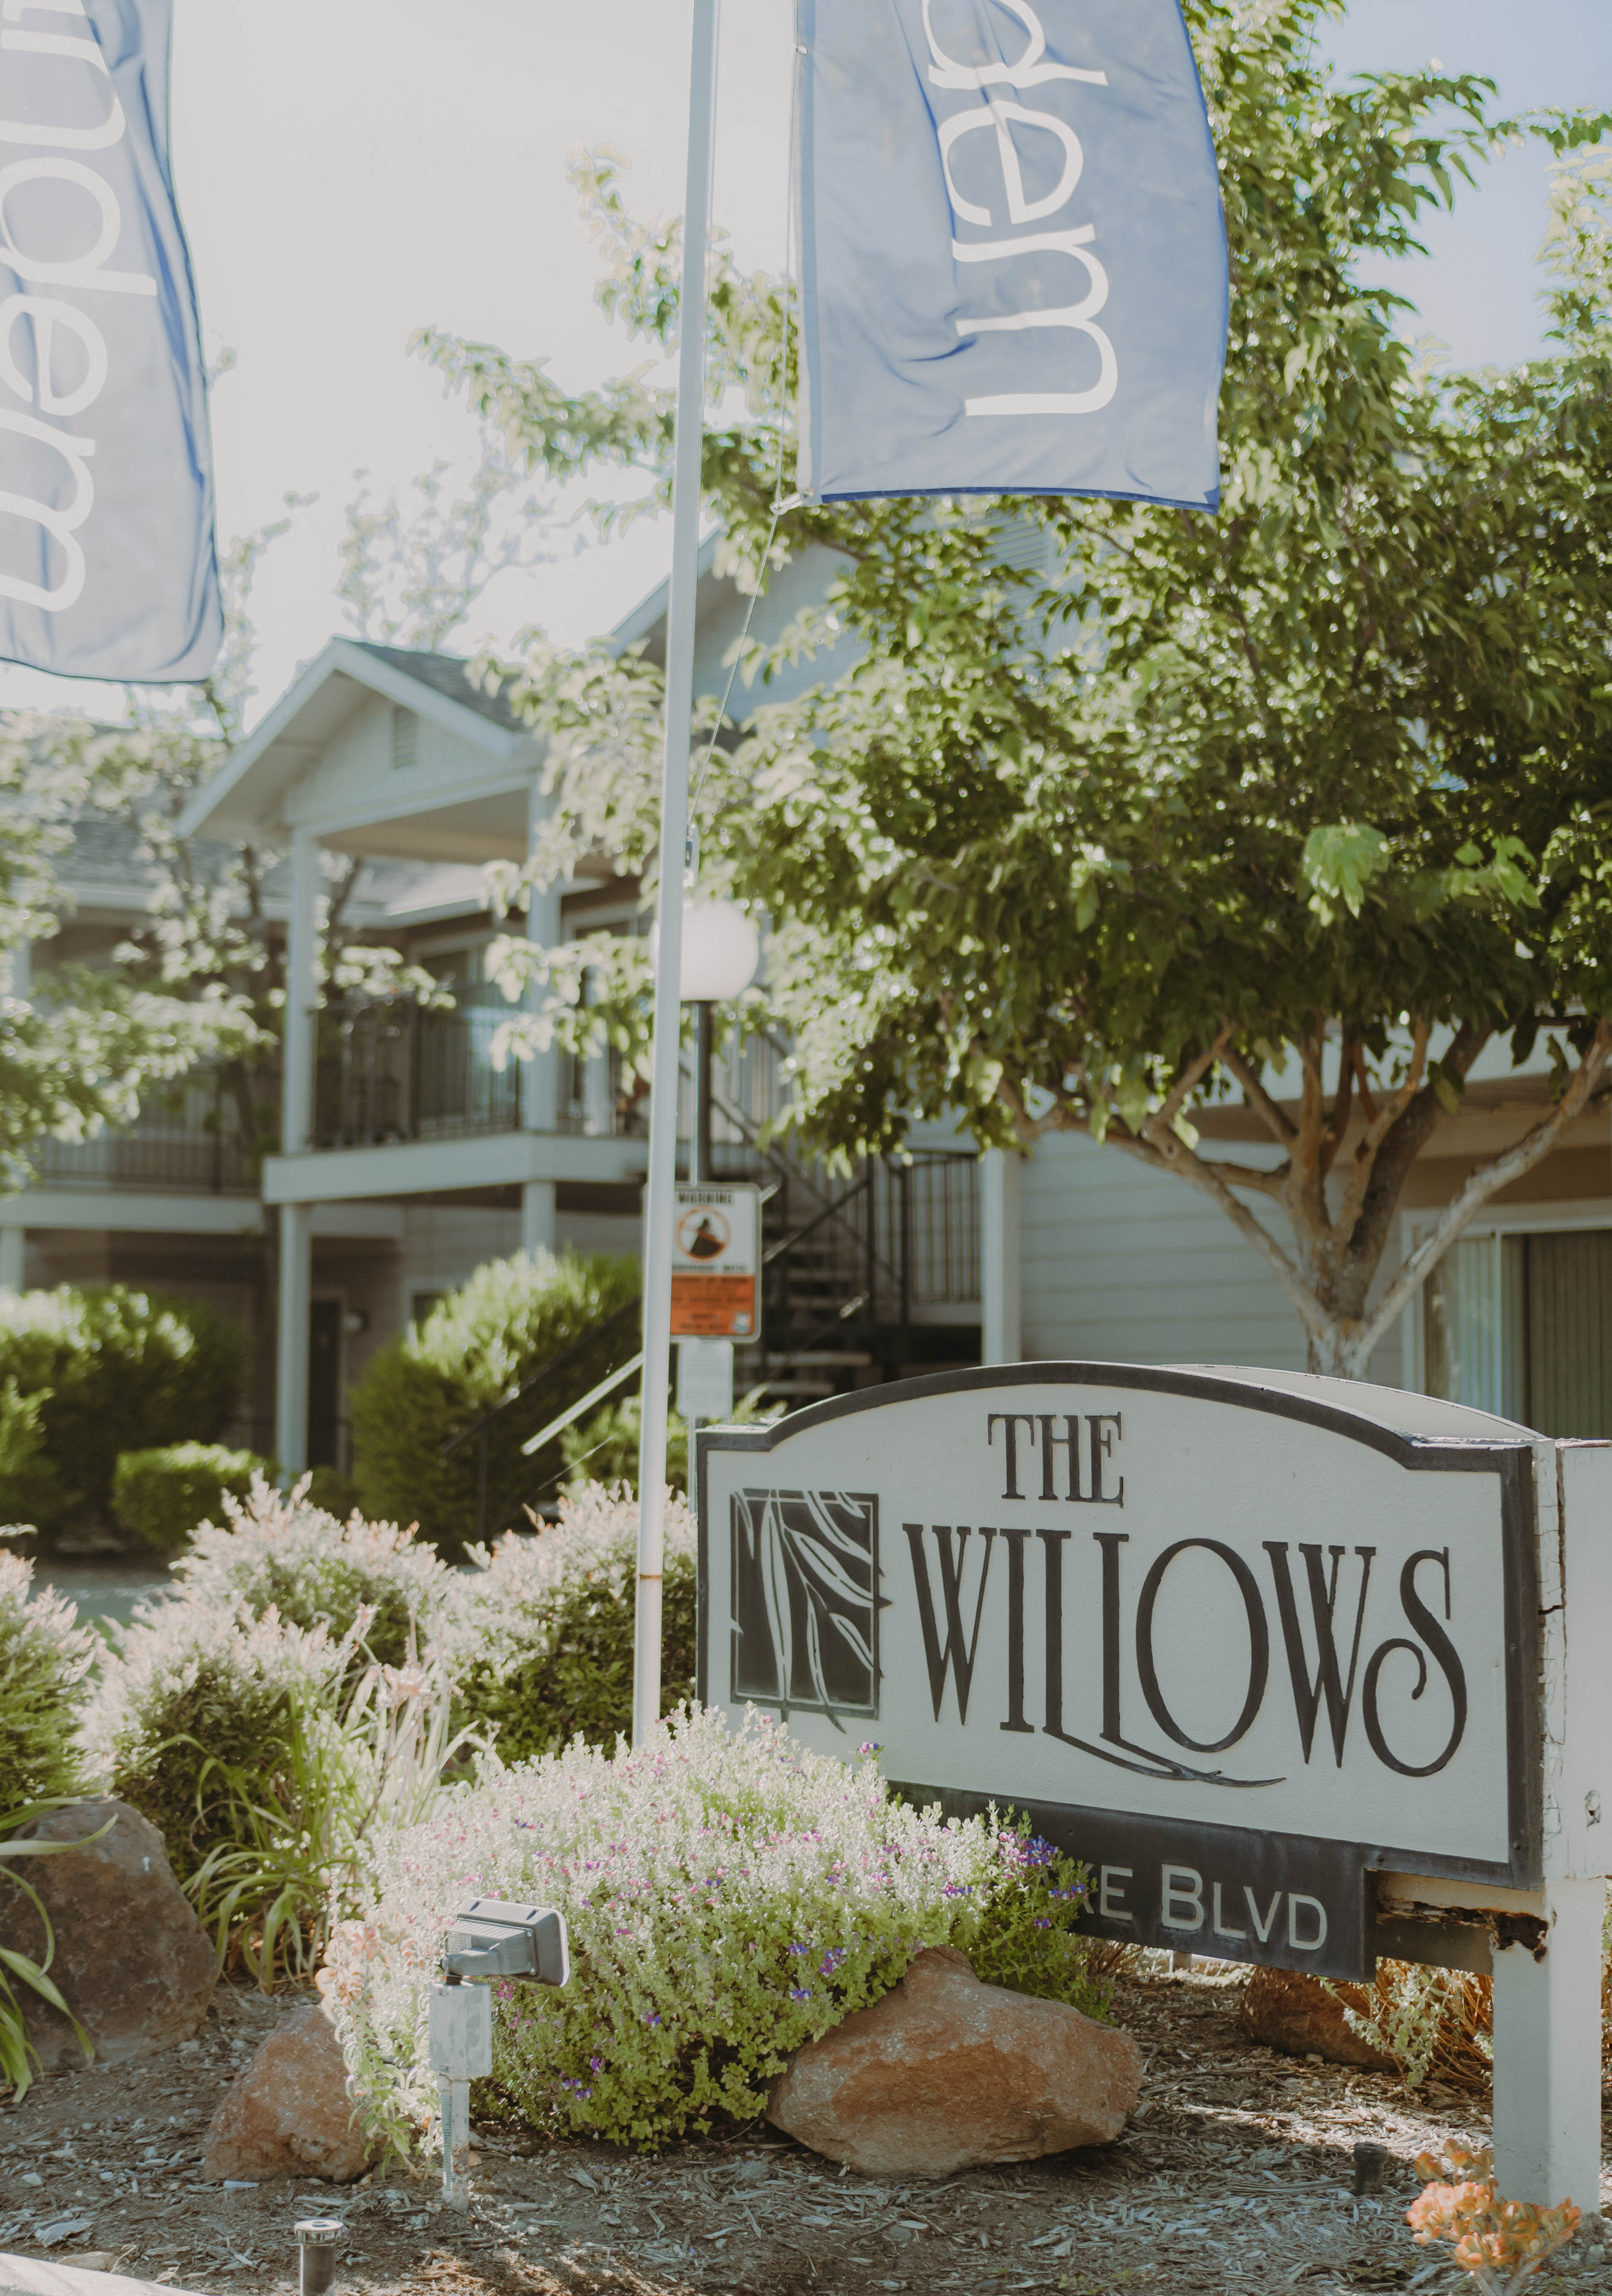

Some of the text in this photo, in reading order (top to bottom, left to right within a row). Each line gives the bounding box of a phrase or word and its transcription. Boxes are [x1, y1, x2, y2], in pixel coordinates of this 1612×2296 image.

[0, 0, 157, 612] ndem
[988, 1412, 1124, 1508] THE
[903, 1523, 1468, 1787] WILLOWS
[1162, 1862, 1328, 1951] BLVD
